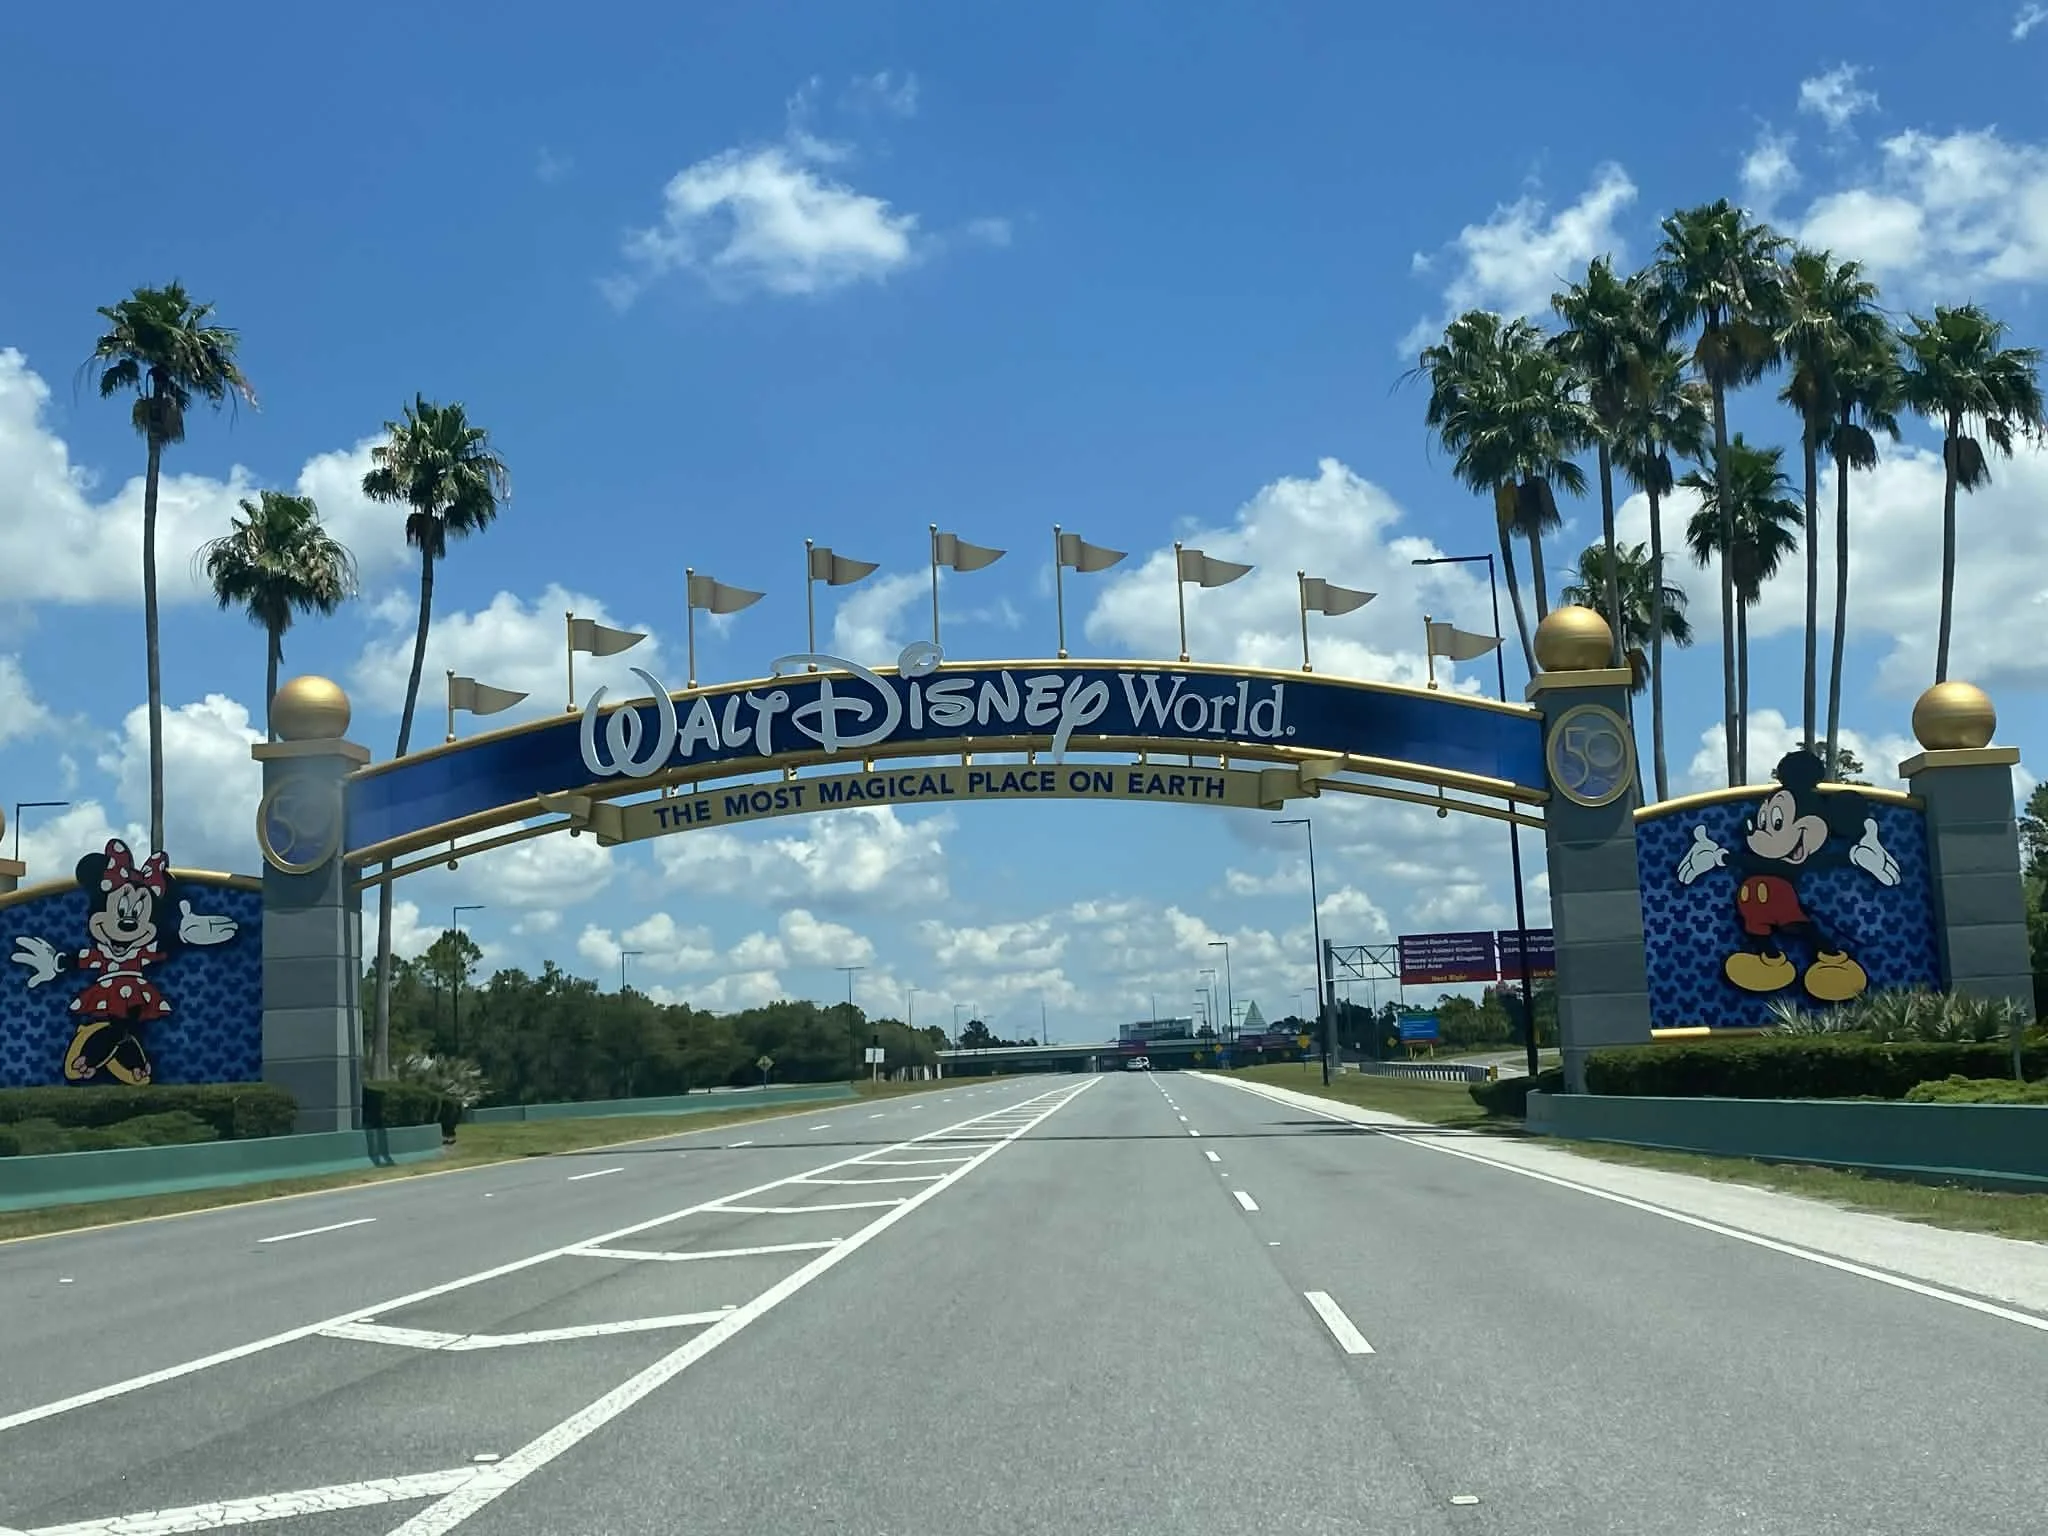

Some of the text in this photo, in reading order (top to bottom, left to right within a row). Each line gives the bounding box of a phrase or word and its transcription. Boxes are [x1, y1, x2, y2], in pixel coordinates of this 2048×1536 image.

[580, 667, 790, 778] WALT
[769, 640, 1110, 765] DISNEY
[653, 770, 1225, 829] THE MOST MAGICAL PLACE ON EARTH
